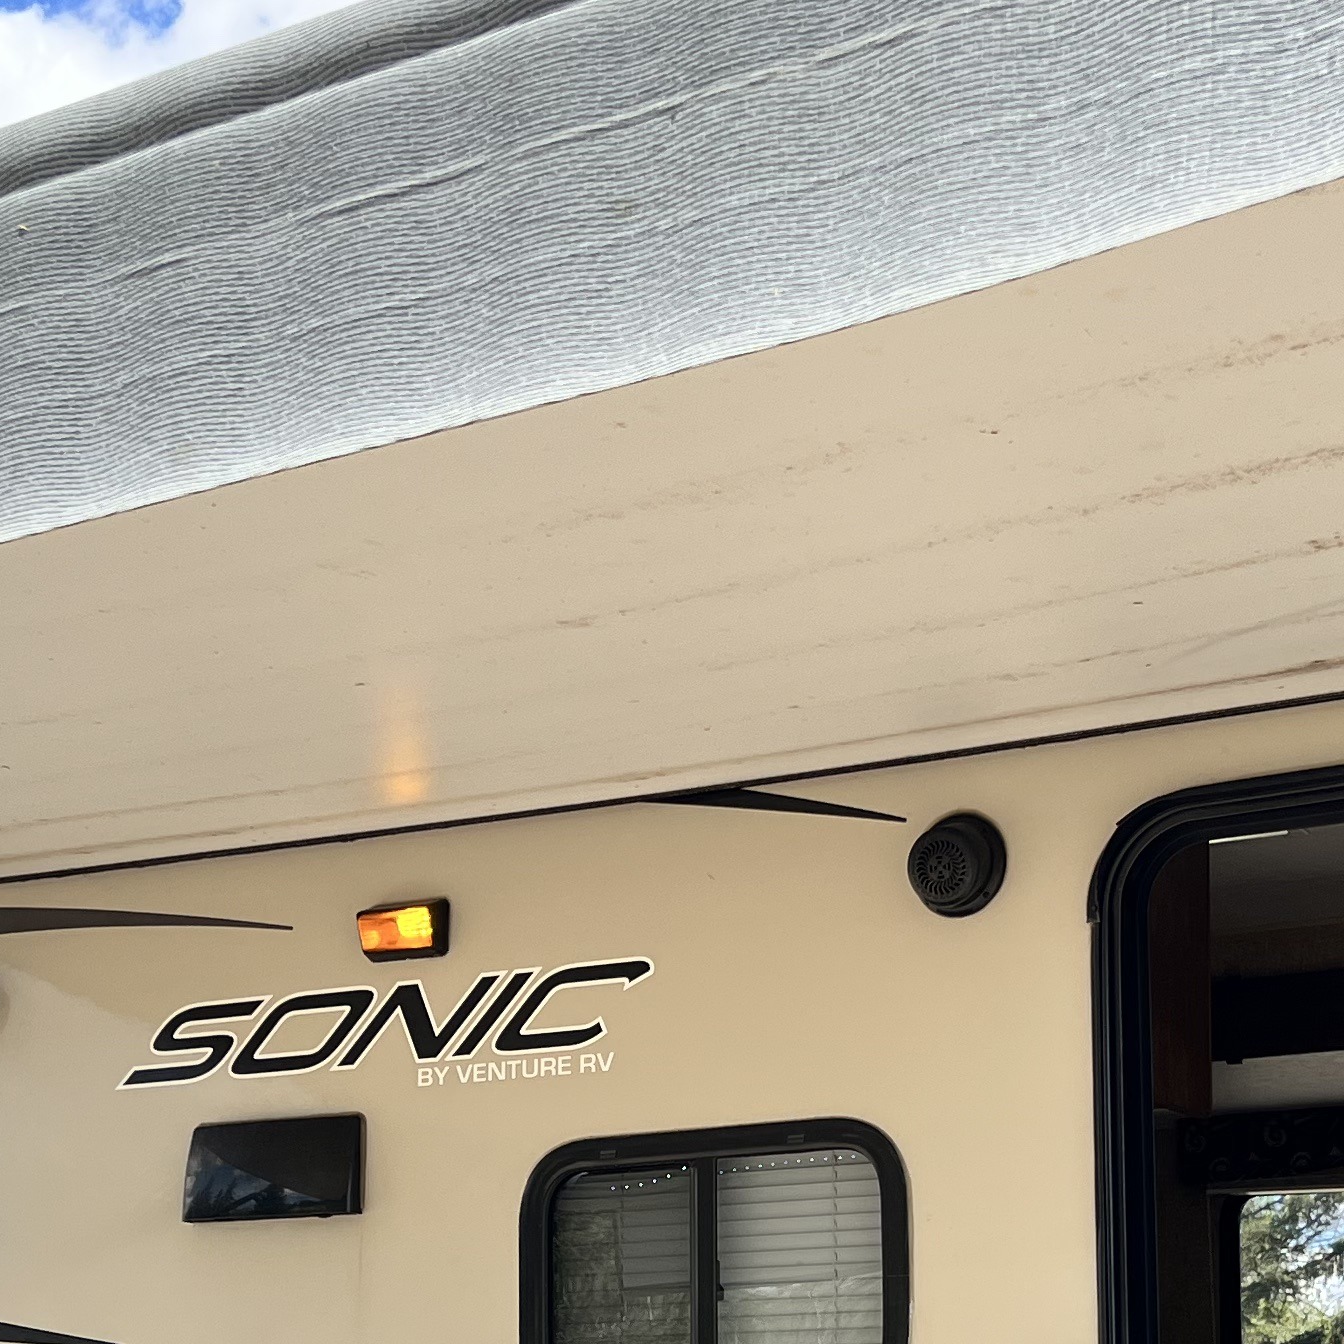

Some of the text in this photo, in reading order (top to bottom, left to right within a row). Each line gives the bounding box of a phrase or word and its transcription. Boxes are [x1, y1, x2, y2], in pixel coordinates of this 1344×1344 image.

[116, 955, 654, 1090] SONIC
[417, 1051, 615, 1087] BY VENTURE RV
